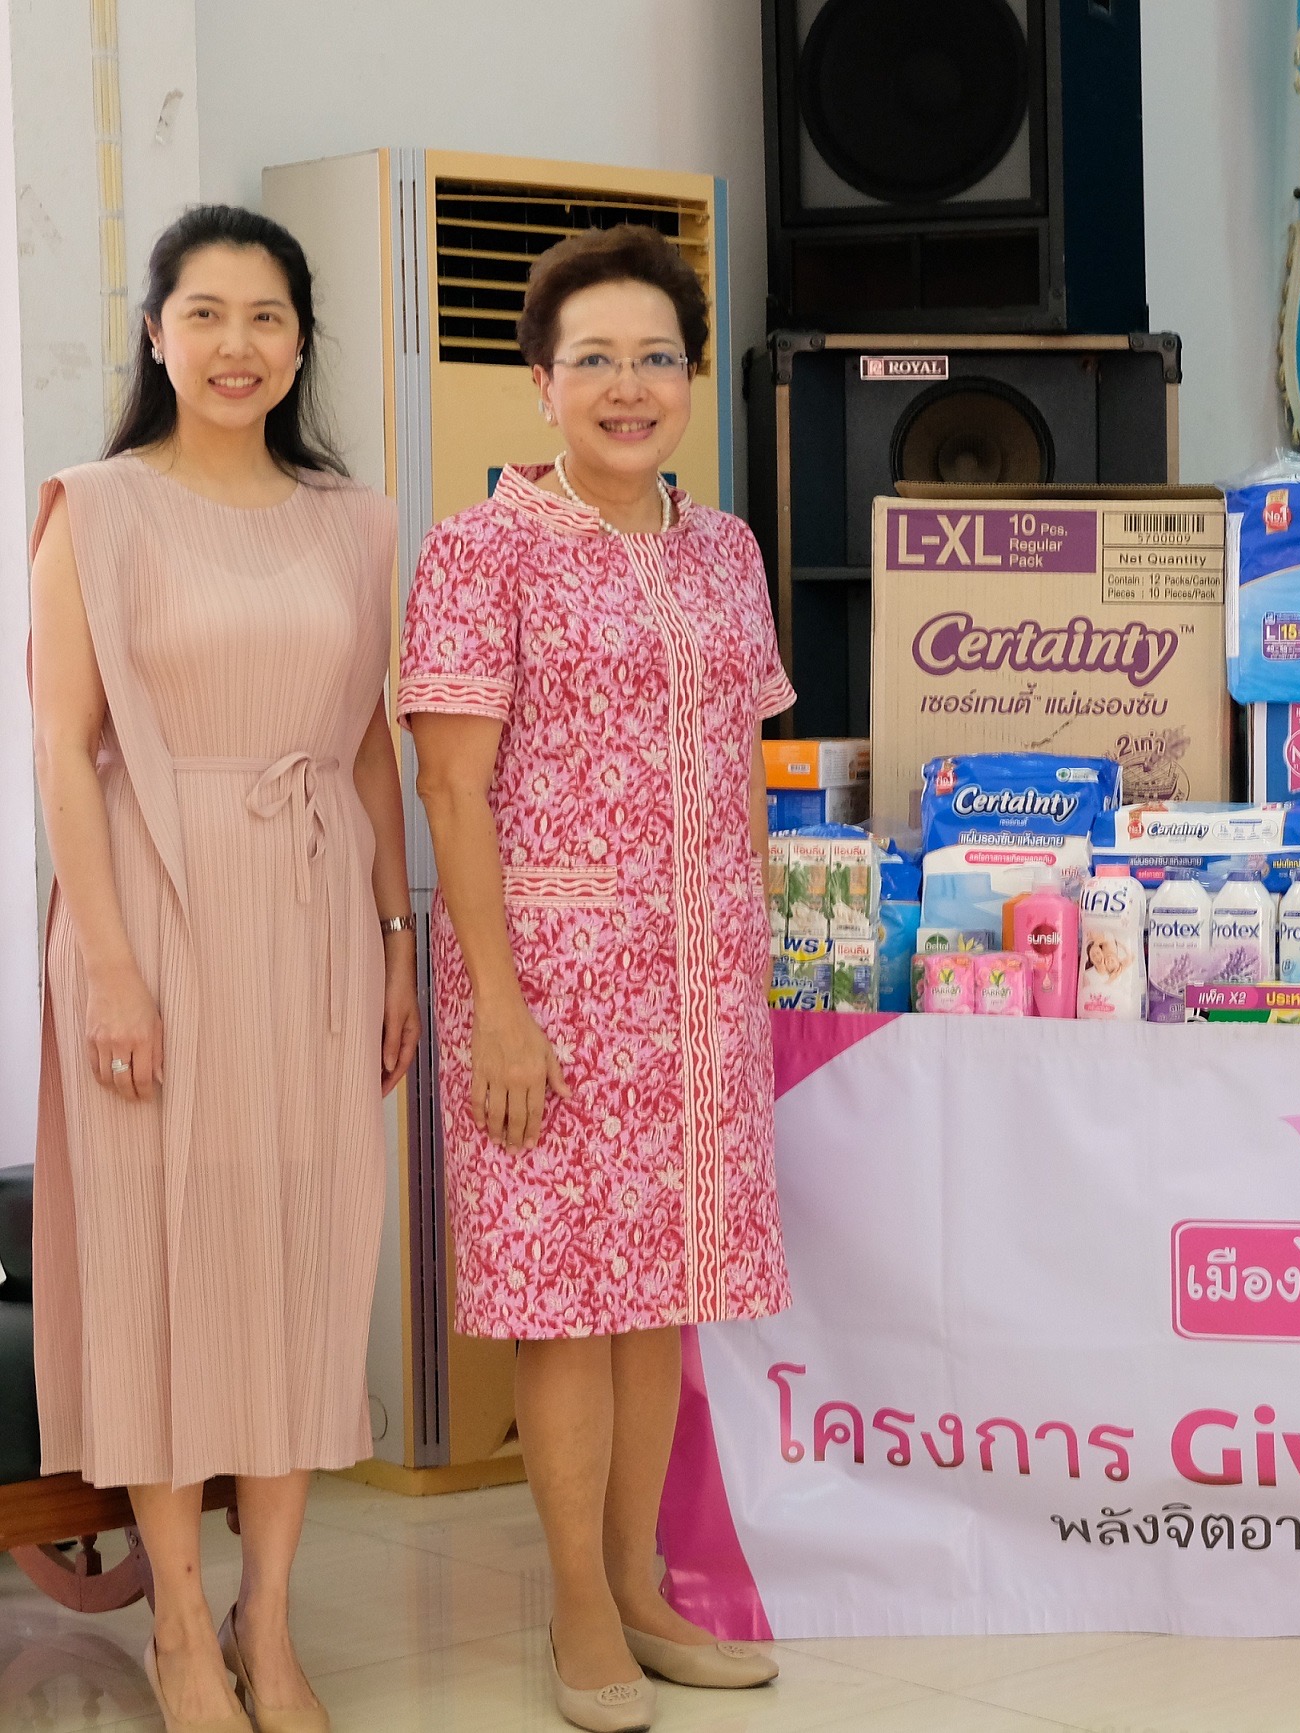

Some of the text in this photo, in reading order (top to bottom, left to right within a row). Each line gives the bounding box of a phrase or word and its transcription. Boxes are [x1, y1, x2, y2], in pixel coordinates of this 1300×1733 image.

[889, 361, 941, 374] ROYAL
[1264, 508, 1289, 524] No.1
[1009, 514, 1068, 537] 10 Pcs.
[898, 514, 1002, 566] L-XL
[1009, 537, 1063, 553] Regular
[1137, 533, 1191, 545] 5700009
[1009, 553, 1044, 568] Pack
[1119, 553, 1207, 567] Net Quantity
[1149, 573, 1161, 586] 12
[1149, 587, 1160, 599] 10
[1266, 625, 1276, 640] L
[913, 611, 1179, 687] Certainty
[920, 682, 1169, 717] เซอร์เทนตี้ แผ่นรองซับ
[954, 785, 1078, 822] Certainty
[1147, 820, 1210, 839] Certainty
[1149, 919, 1202, 938] Protex
[1211, 920, 1261, 940] Protex
[1027, 933, 1063, 945] sunsilk
[1198, 988, 1225, 1005] แพ็ค
[1229, 991, 1247, 1005] X2
[766, 1361, 1135, 1483] โครงการ
